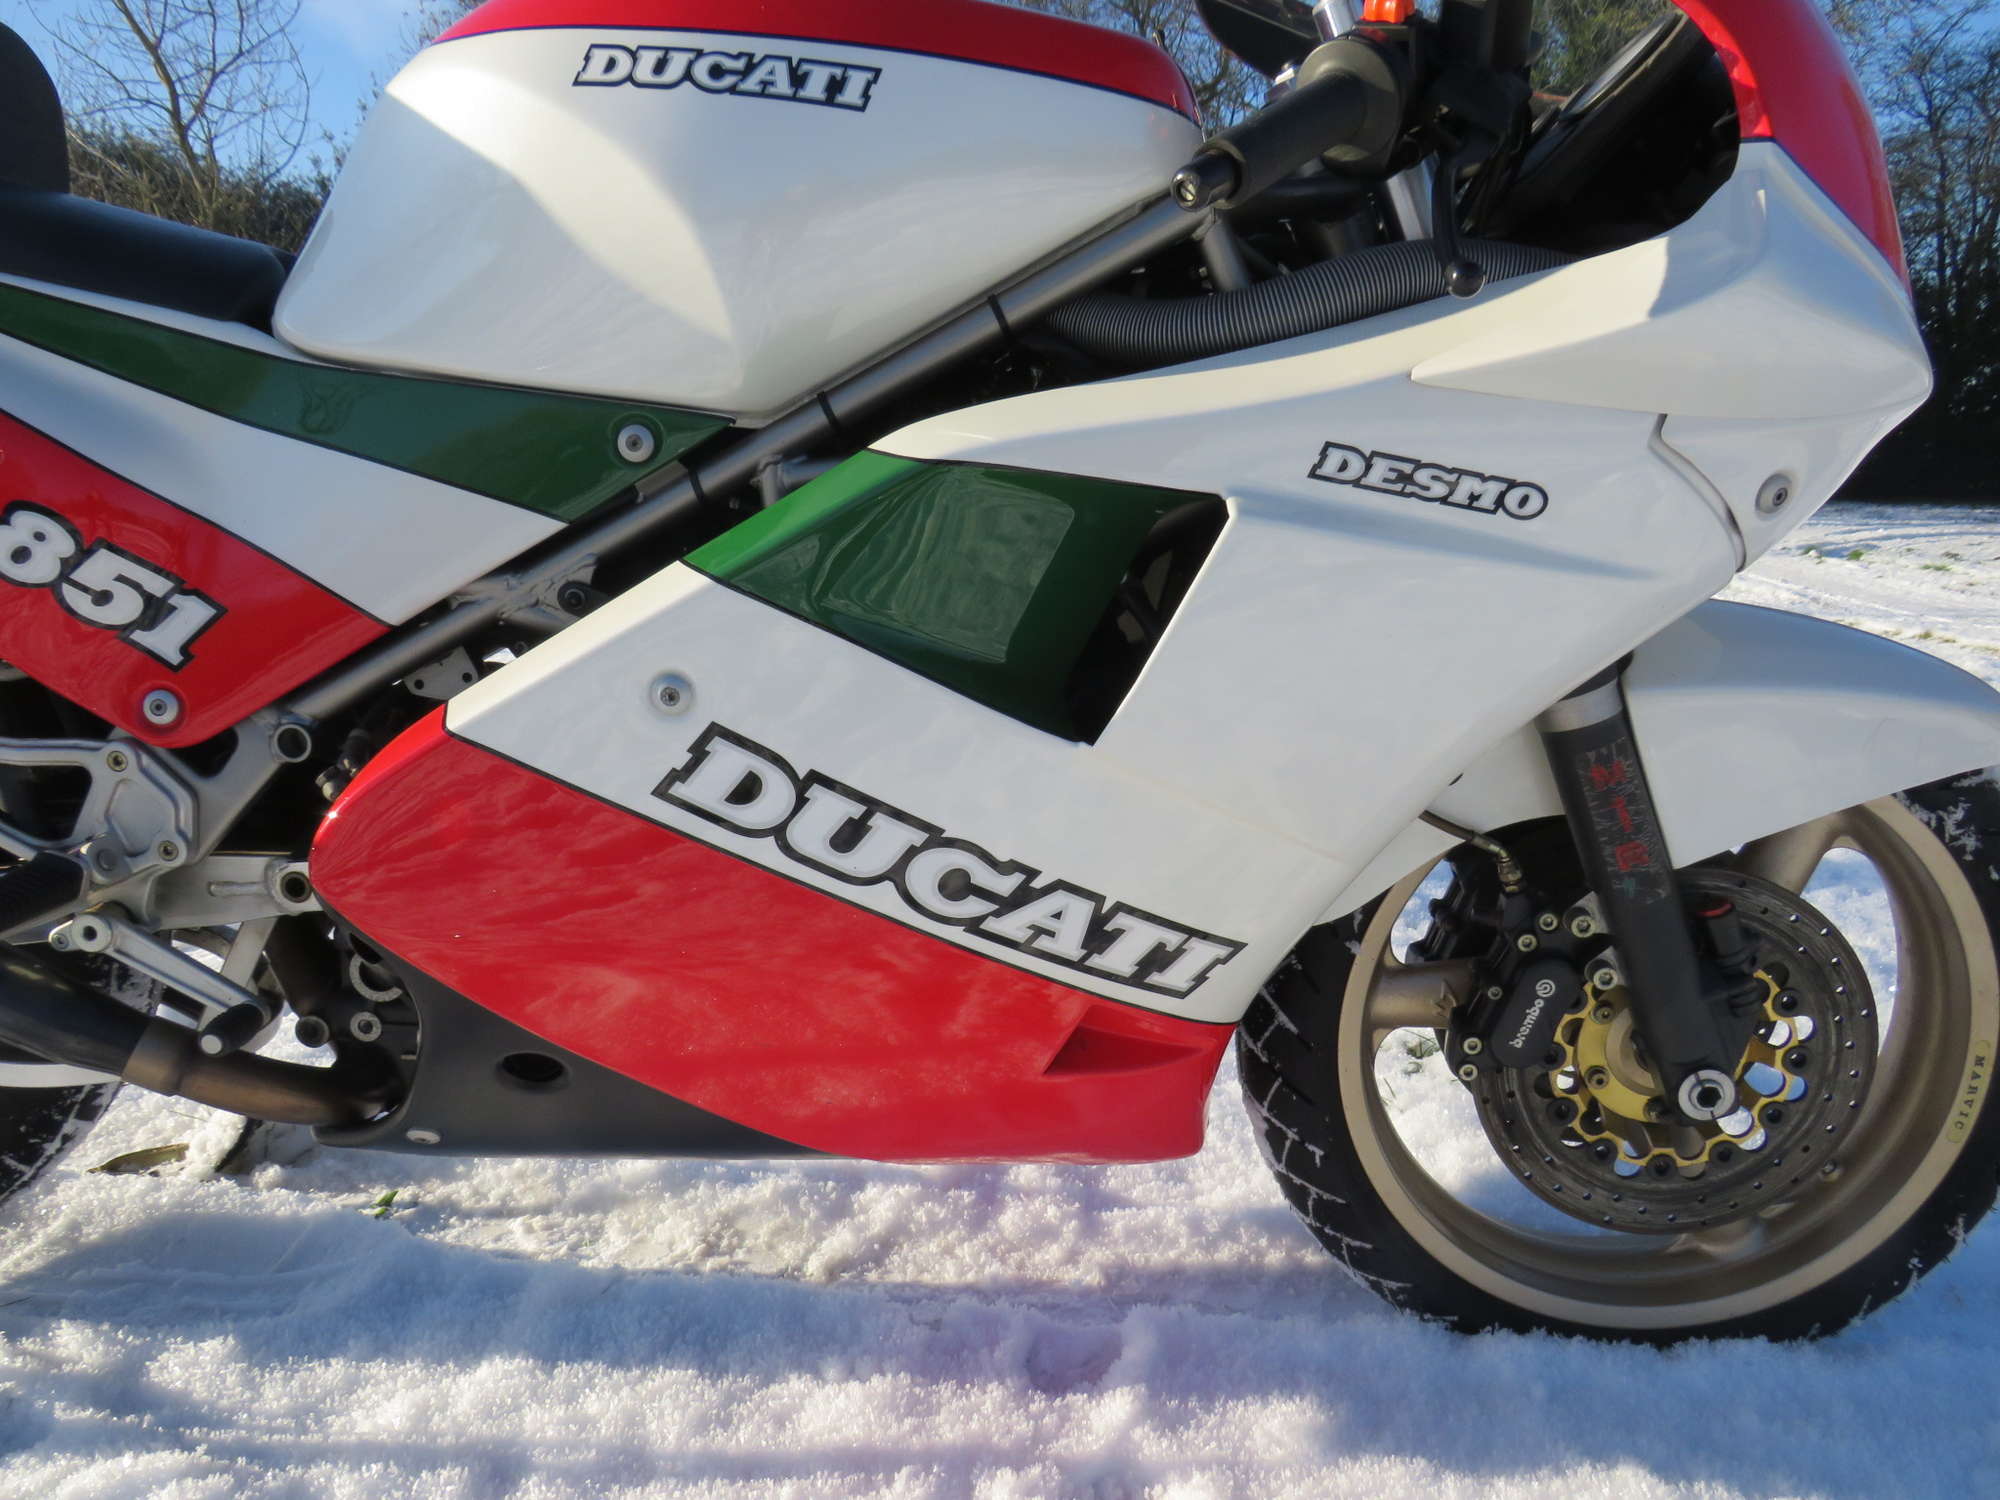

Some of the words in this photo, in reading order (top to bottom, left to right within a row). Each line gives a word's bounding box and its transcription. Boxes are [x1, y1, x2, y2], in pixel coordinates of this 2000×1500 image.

[572, 44, 882, 112] DUCATI
[1307, 441, 1549, 521] DESMO
[0, 500, 228, 672] 851
[651, 721, 1248, 999] DUCATI
[1508, 998, 1545, 1049] brembo
[1954, 1055, 1986, 1130] MARVIC
